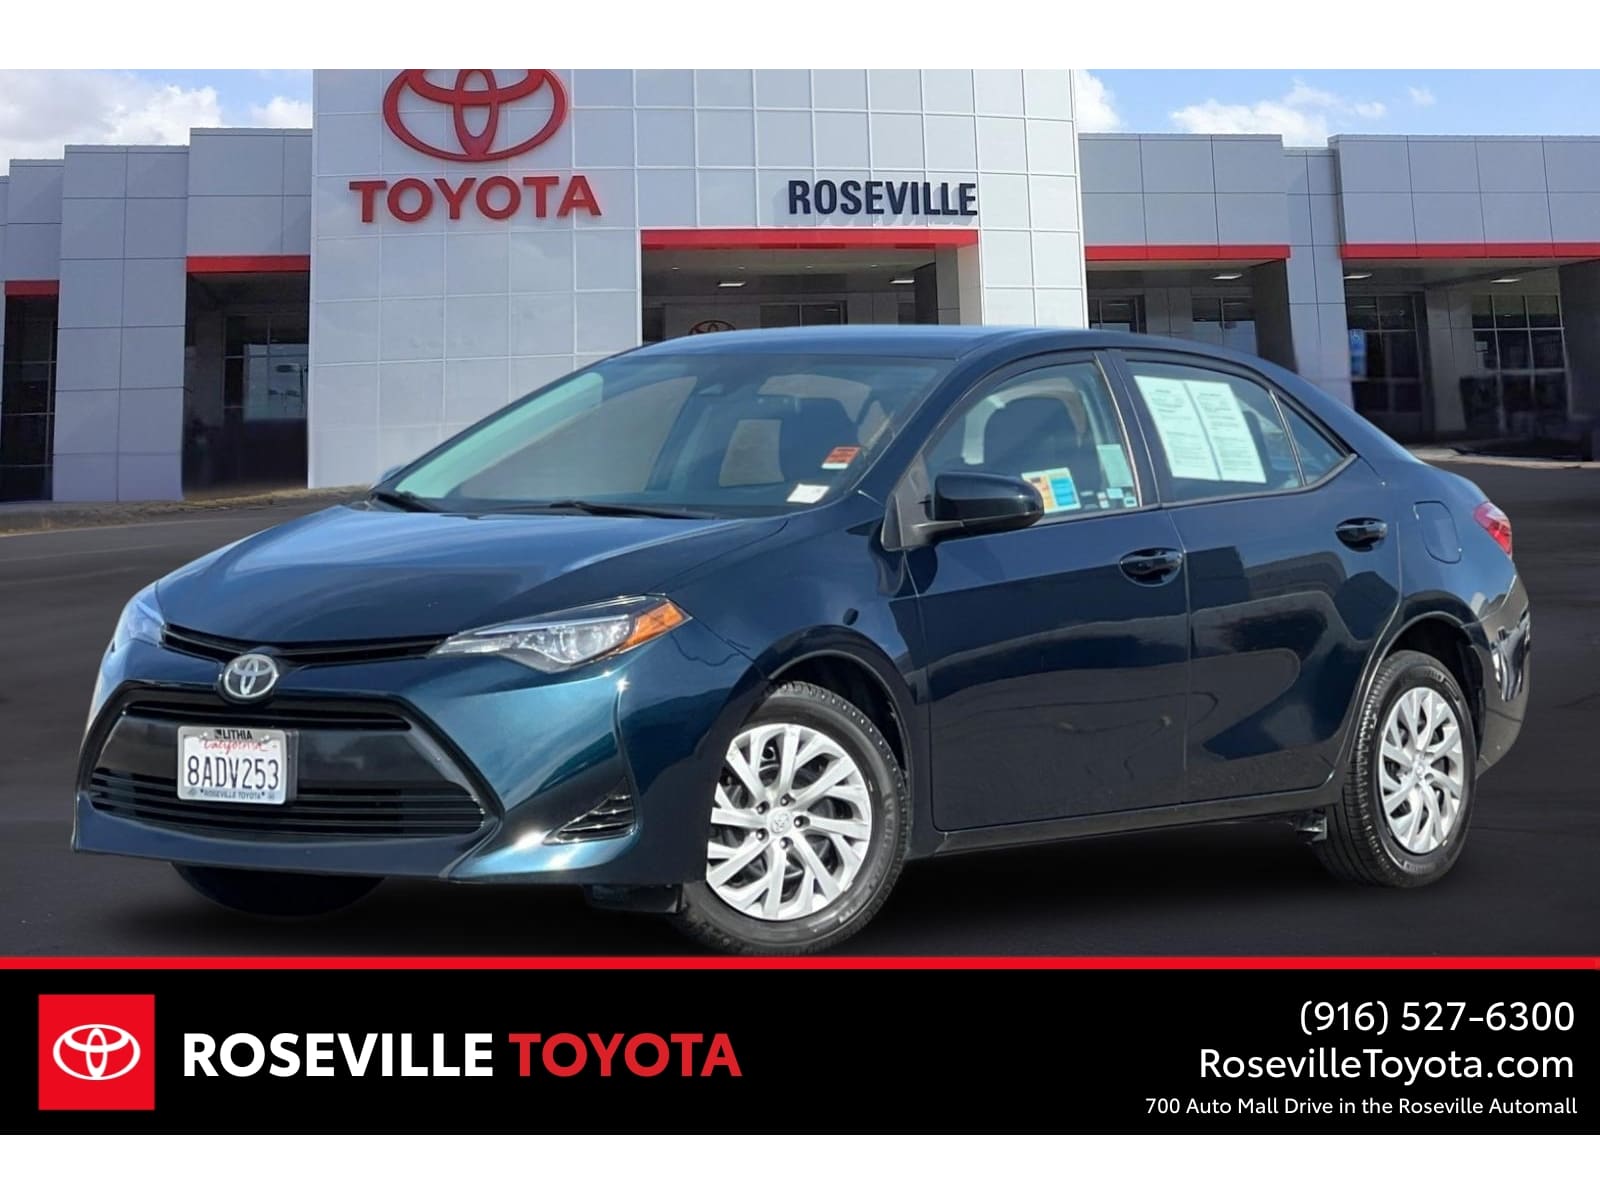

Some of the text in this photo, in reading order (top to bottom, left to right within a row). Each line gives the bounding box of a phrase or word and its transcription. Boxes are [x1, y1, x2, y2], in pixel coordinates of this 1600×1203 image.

[349, 175, 602, 223] TOYOTA
[788, 180, 978, 216] ROSEVILLE
[222, 729, 253, 740] LITHIA
[202, 740, 270, 755] California
[187, 755, 280, 790] 8ADV253
[203, 789, 261, 800] ROSEVILLE TOYOTA
